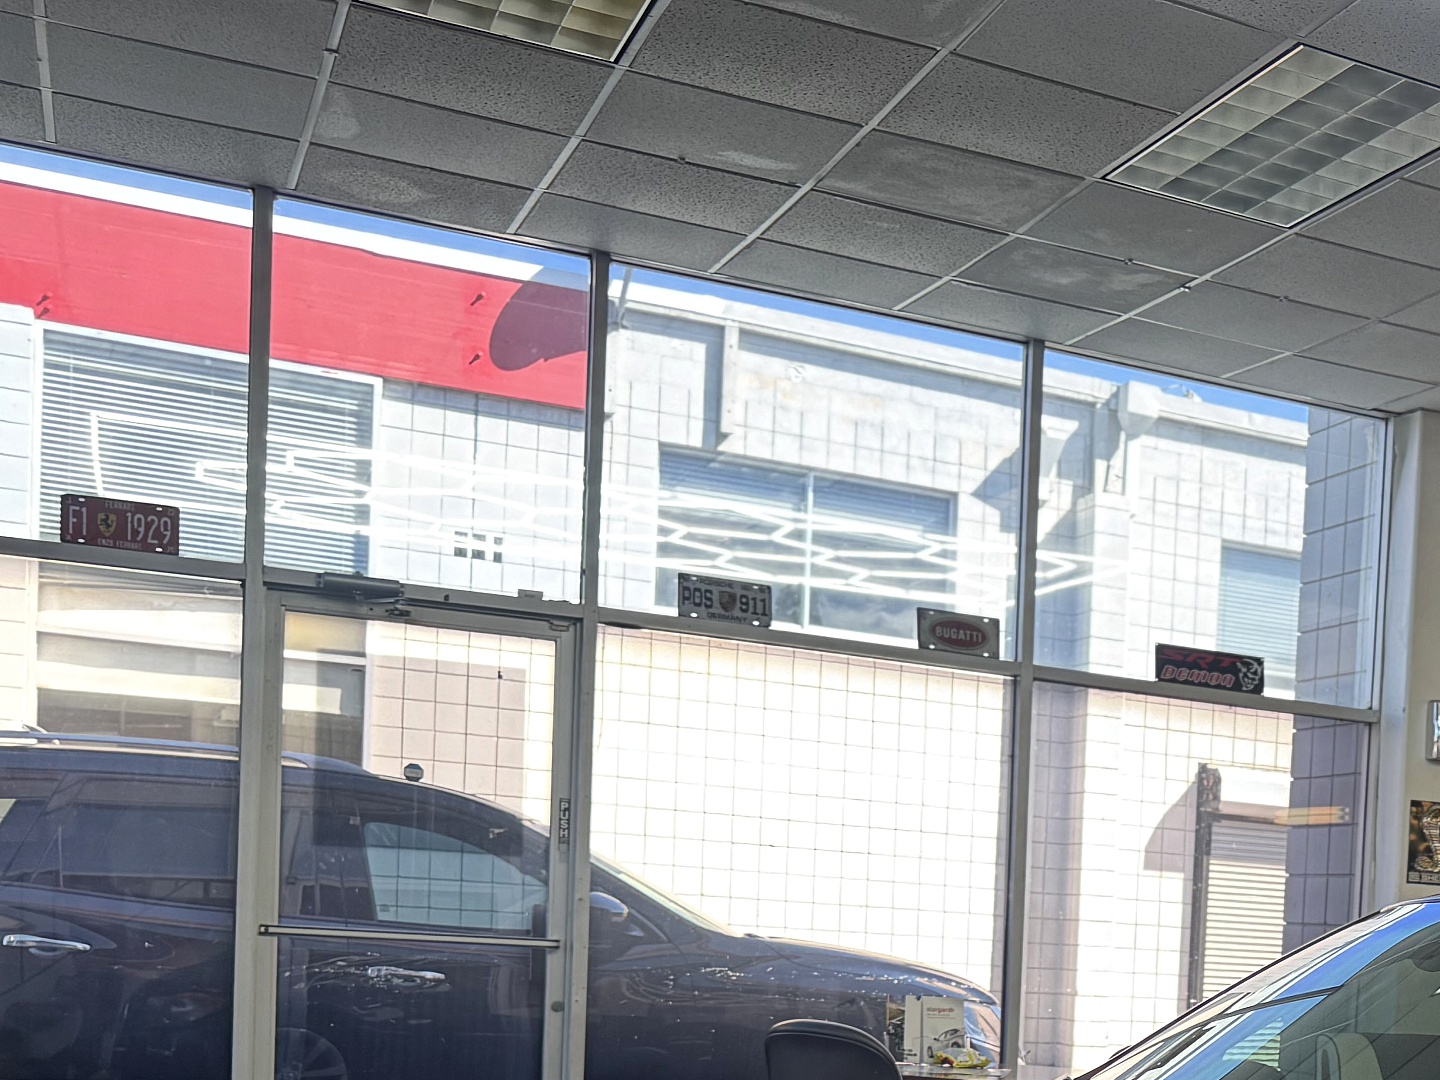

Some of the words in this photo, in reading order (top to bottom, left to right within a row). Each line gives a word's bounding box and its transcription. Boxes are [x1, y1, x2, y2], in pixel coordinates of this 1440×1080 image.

[68, 505, 87, 536] F1
[126, 512, 172, 545] 1929
[682, 586, 714, 610] POS
[739, 594, 769, 617] 911
[707, 612, 747, 623] GERMANY
[935, 626, 982, 643] BUGATTI
[1161, 649, 1244, 669] SRT
[560, 801, 569, 838] PUSH
